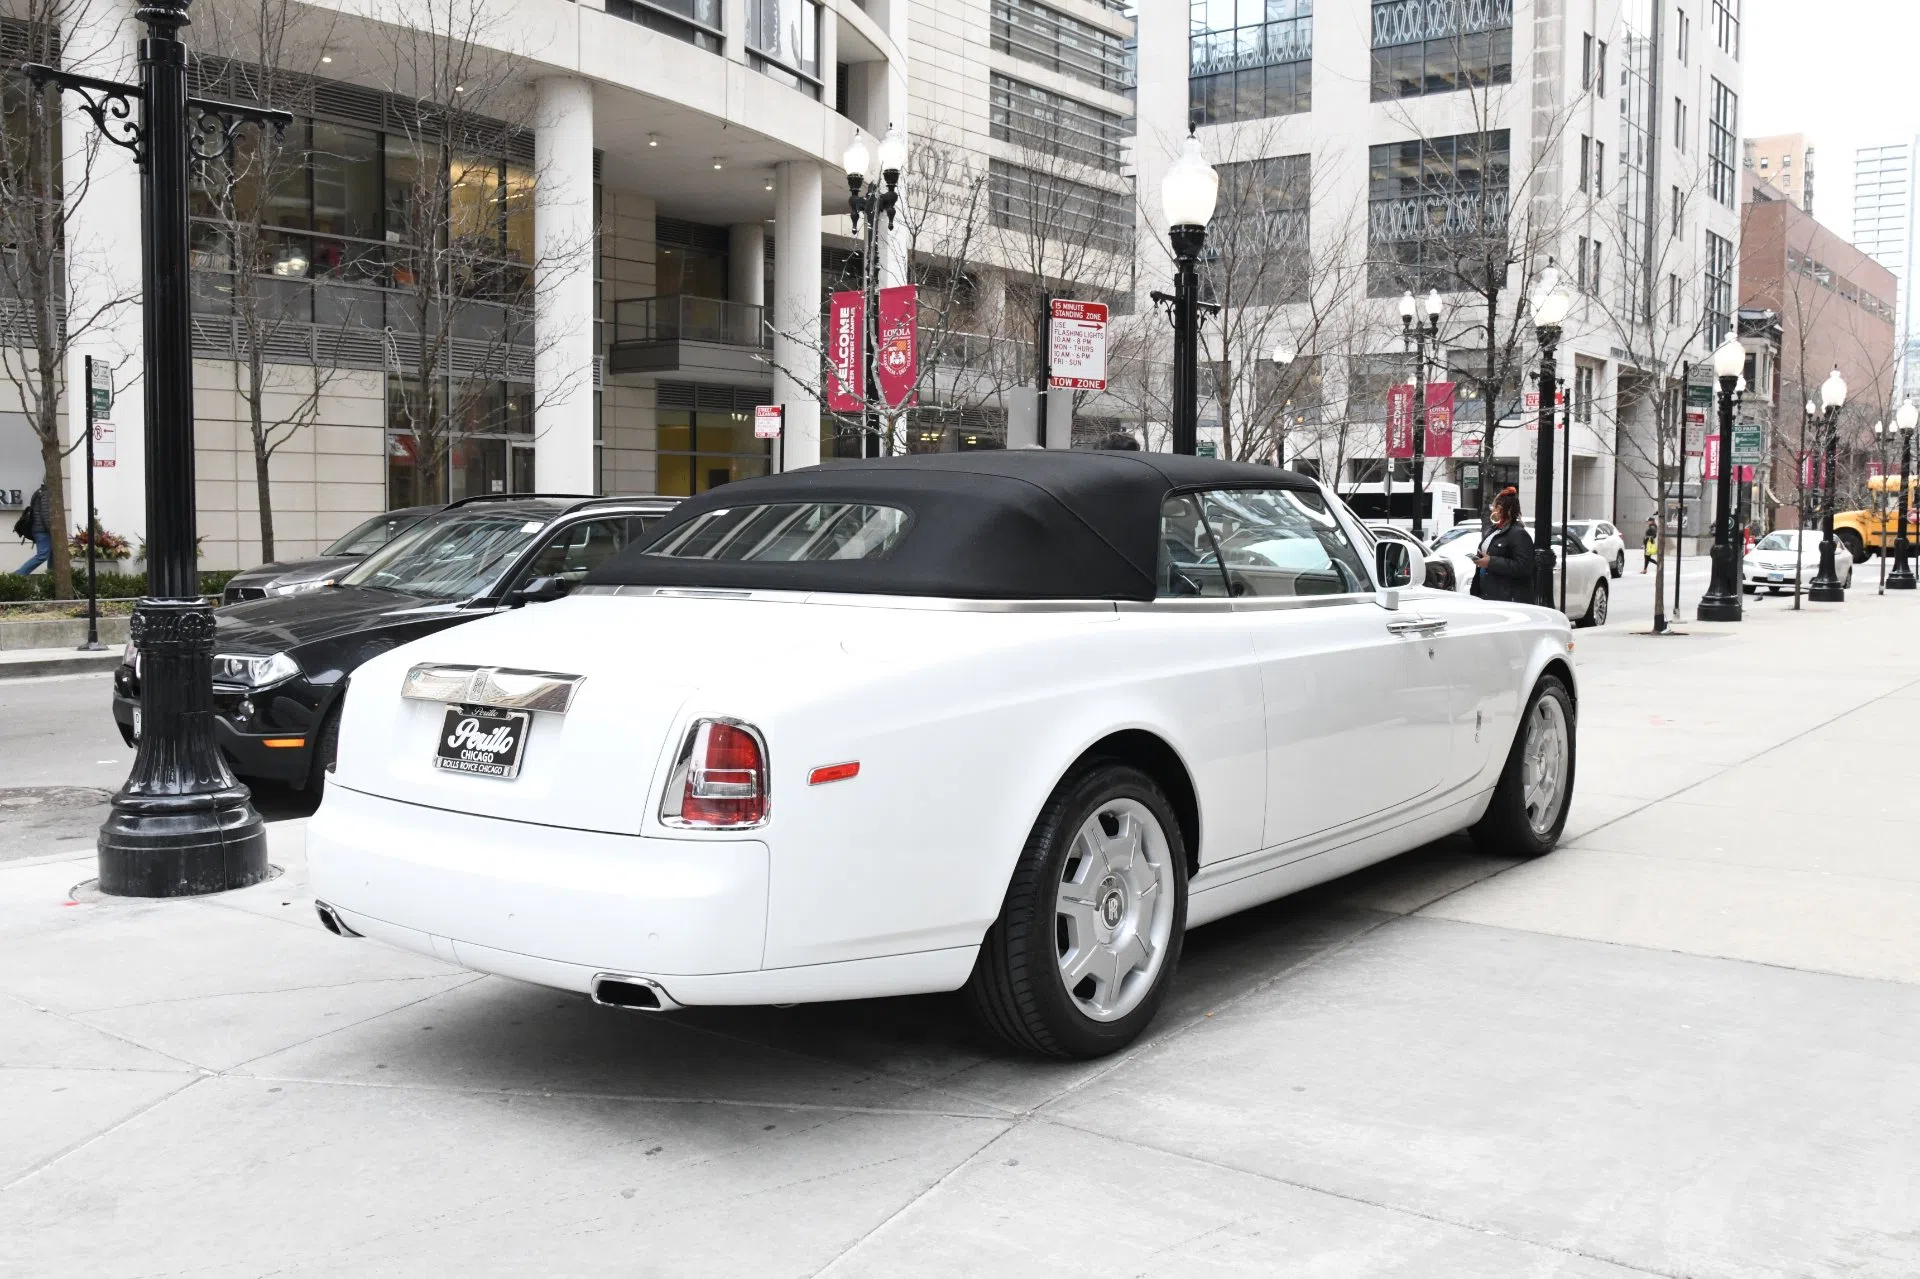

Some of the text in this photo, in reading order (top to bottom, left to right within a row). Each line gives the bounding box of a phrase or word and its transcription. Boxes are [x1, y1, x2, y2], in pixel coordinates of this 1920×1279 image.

[1063, 303, 1084, 311] MINUTE
[1055, 310, 1084, 318] STANDING
[883, 328, 911, 337] LOYOLA
[1054, 329, 1104, 340] FLASHING LIGHTS
[838, 307, 850, 396] WELCOME
[1074, 345, 1094, 353] THURS
[1054, 378, 1101, 389] TOW ZONE
[447, 718, 514, 754] Perillo
[461, 750, 494, 762] CHICAGO
[442, 759, 502, 774] ROLLS ROYCE CHICAGO
